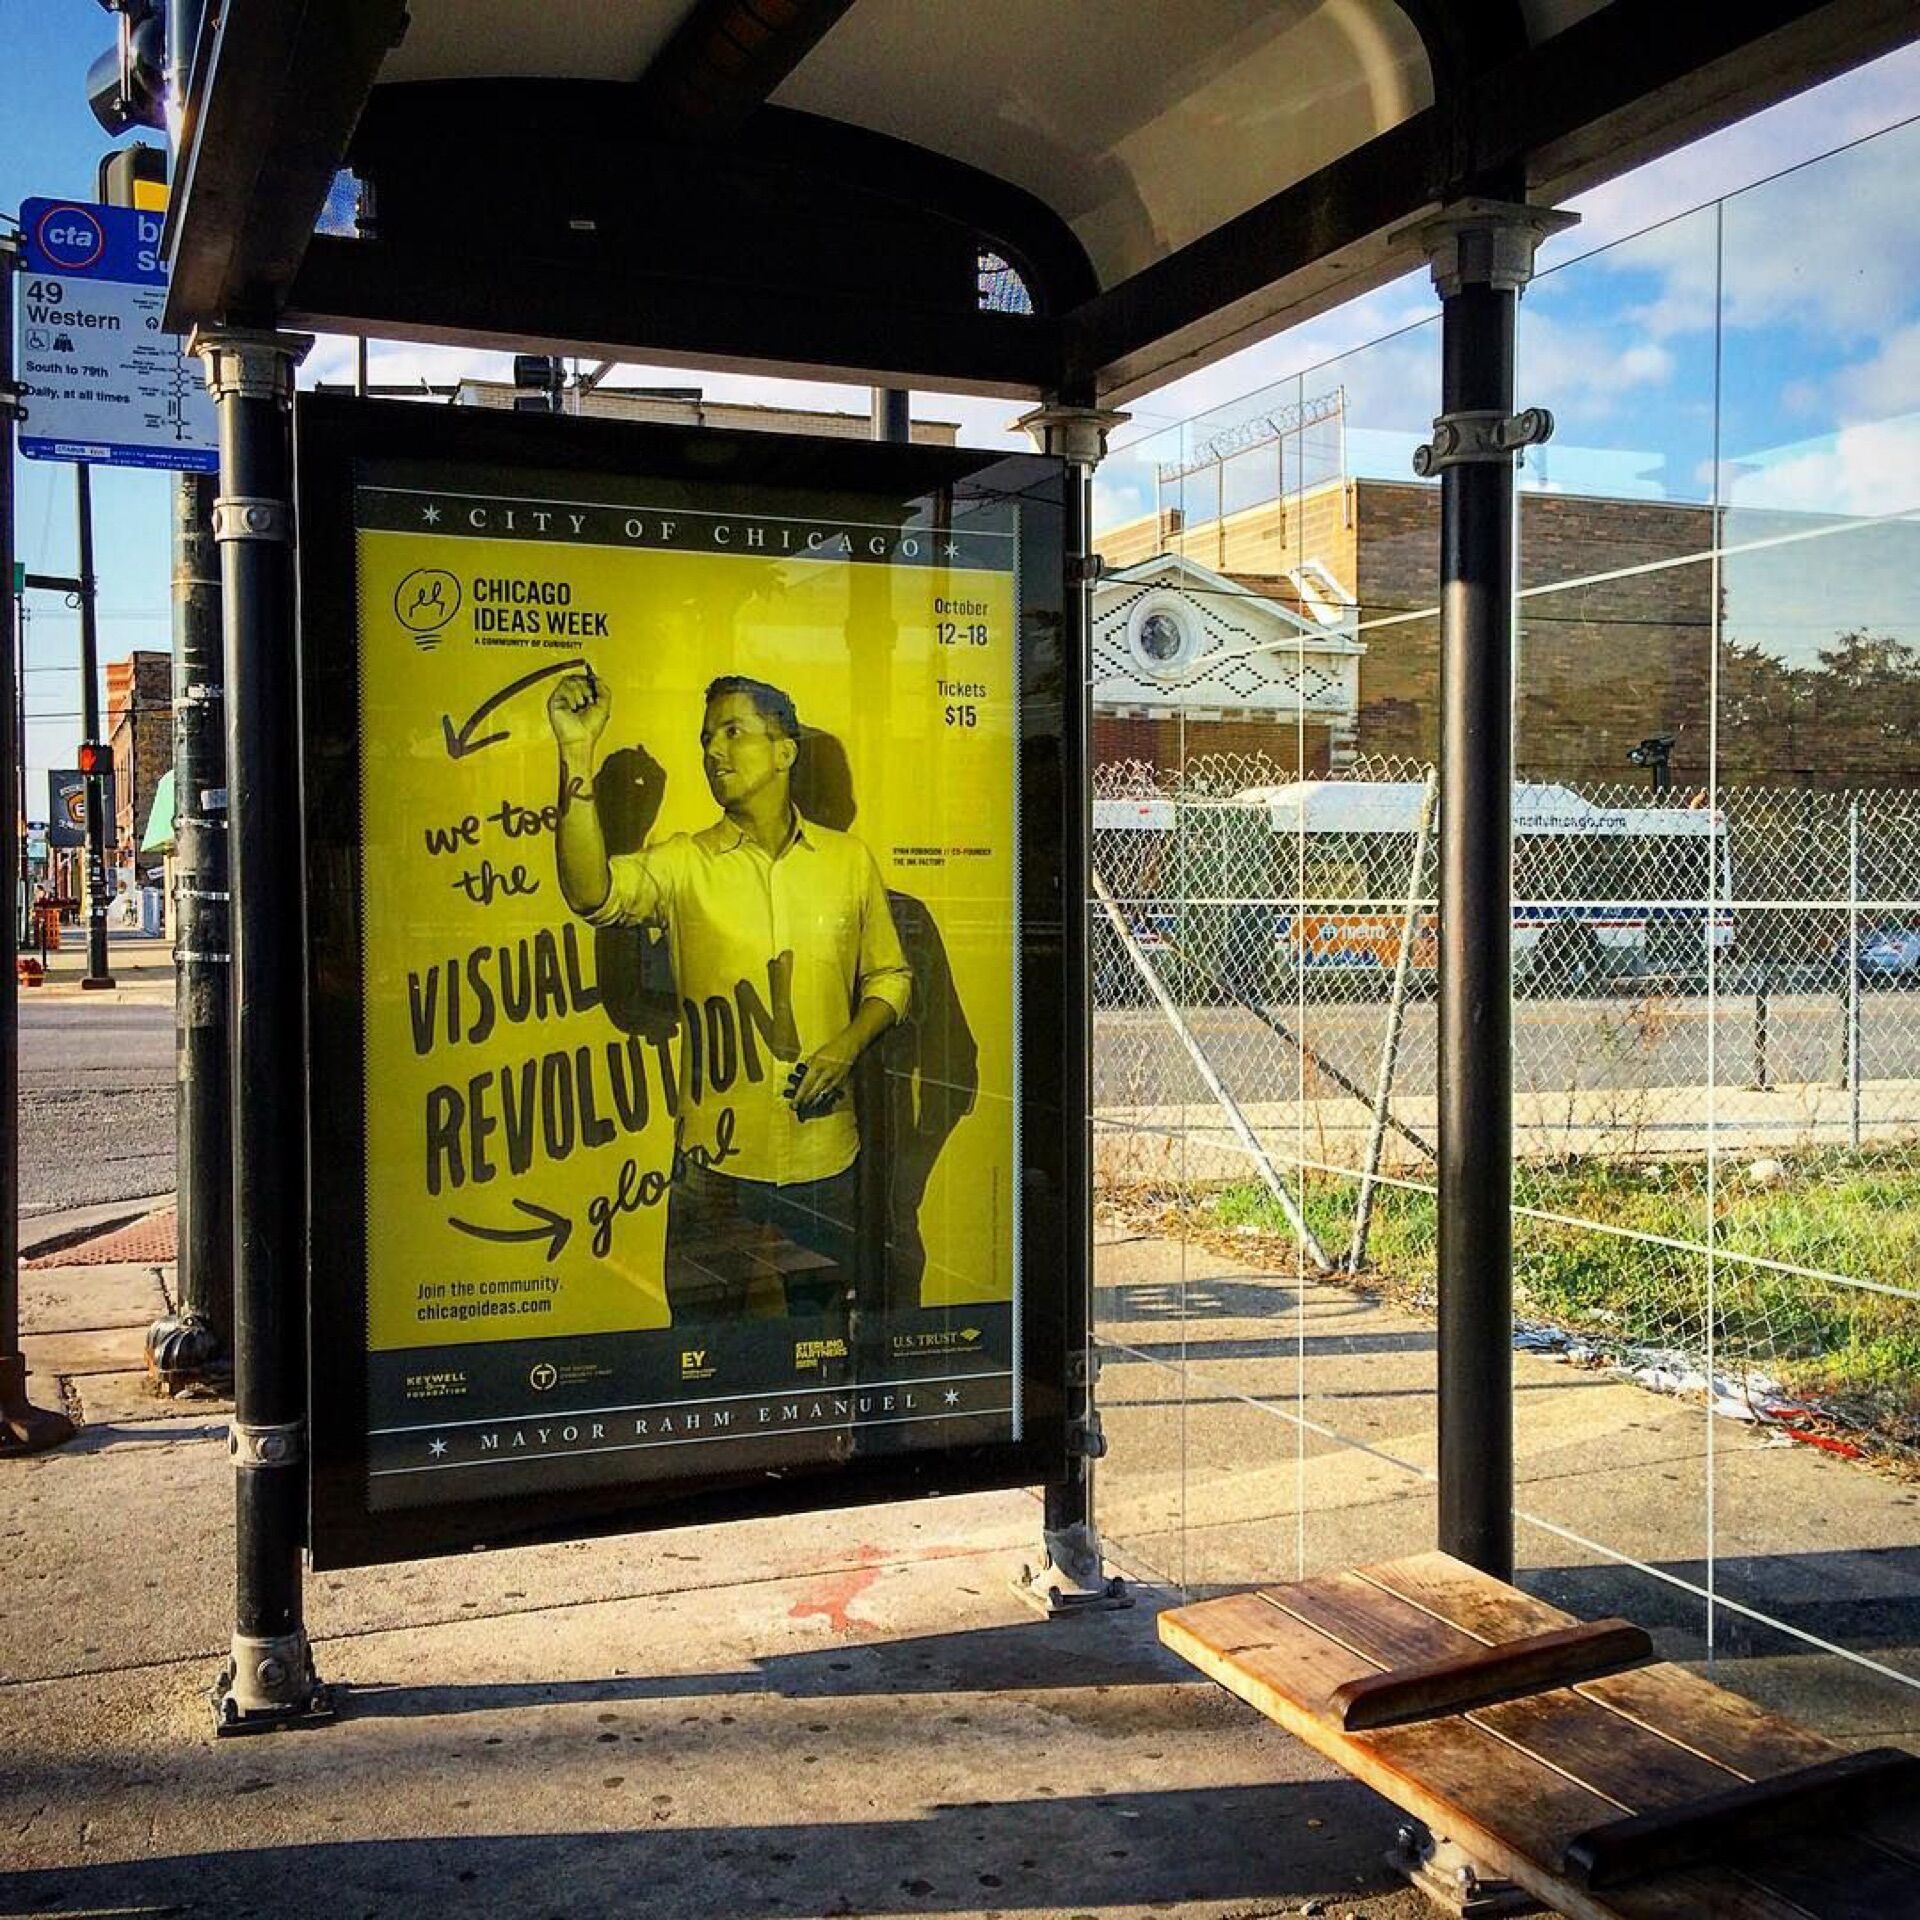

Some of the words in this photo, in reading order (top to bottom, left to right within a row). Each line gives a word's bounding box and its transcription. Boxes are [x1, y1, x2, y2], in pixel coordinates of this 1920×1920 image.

[49, 226, 92, 247] cta
[27, 281, 63, 304] 49
[27, 305, 120, 330] Western
[26, 361, 62, 373] South
[66, 365, 78, 375] to
[81, 366, 109, 377] 79th
[64, 390, 75, 399] at
[78, 389, 93, 400] all
[96, 391, 130, 403] times
[468, 508, 588, 534] CITY
[624, 519, 677, 540] OF
[713, 525, 919, 557] CHICAGO
[473, 578, 571, 606] CHICAGO
[934, 598, 988, 616] October
[474, 608, 540, 634] IDEAS
[547, 612, 609, 637] WEEK
[937, 680, 986, 699] Tickets
[945, 705, 977, 728] $15
[425, 814, 480, 855] we
[452, 860, 540, 906] the
[407, 922, 603, 1055] VISUAL
[425, 949, 803, 1197] REVOLUTION
[588, 1107, 741, 1259] global
[417, 1283, 446, 1300] Join
[450, 1279, 476, 1297] the
[479, 1276, 563, 1296] community.
[417, 1298, 552, 1322] chicagoideas.com
[917, 1331, 958, 1346] TRUST
[682, 1350, 705, 1367] EY
[481, 1424, 604, 1450] MAYOR
[635, 1411, 731, 1435] RAHM
[760, 1393, 917, 1423] EMANUEL
